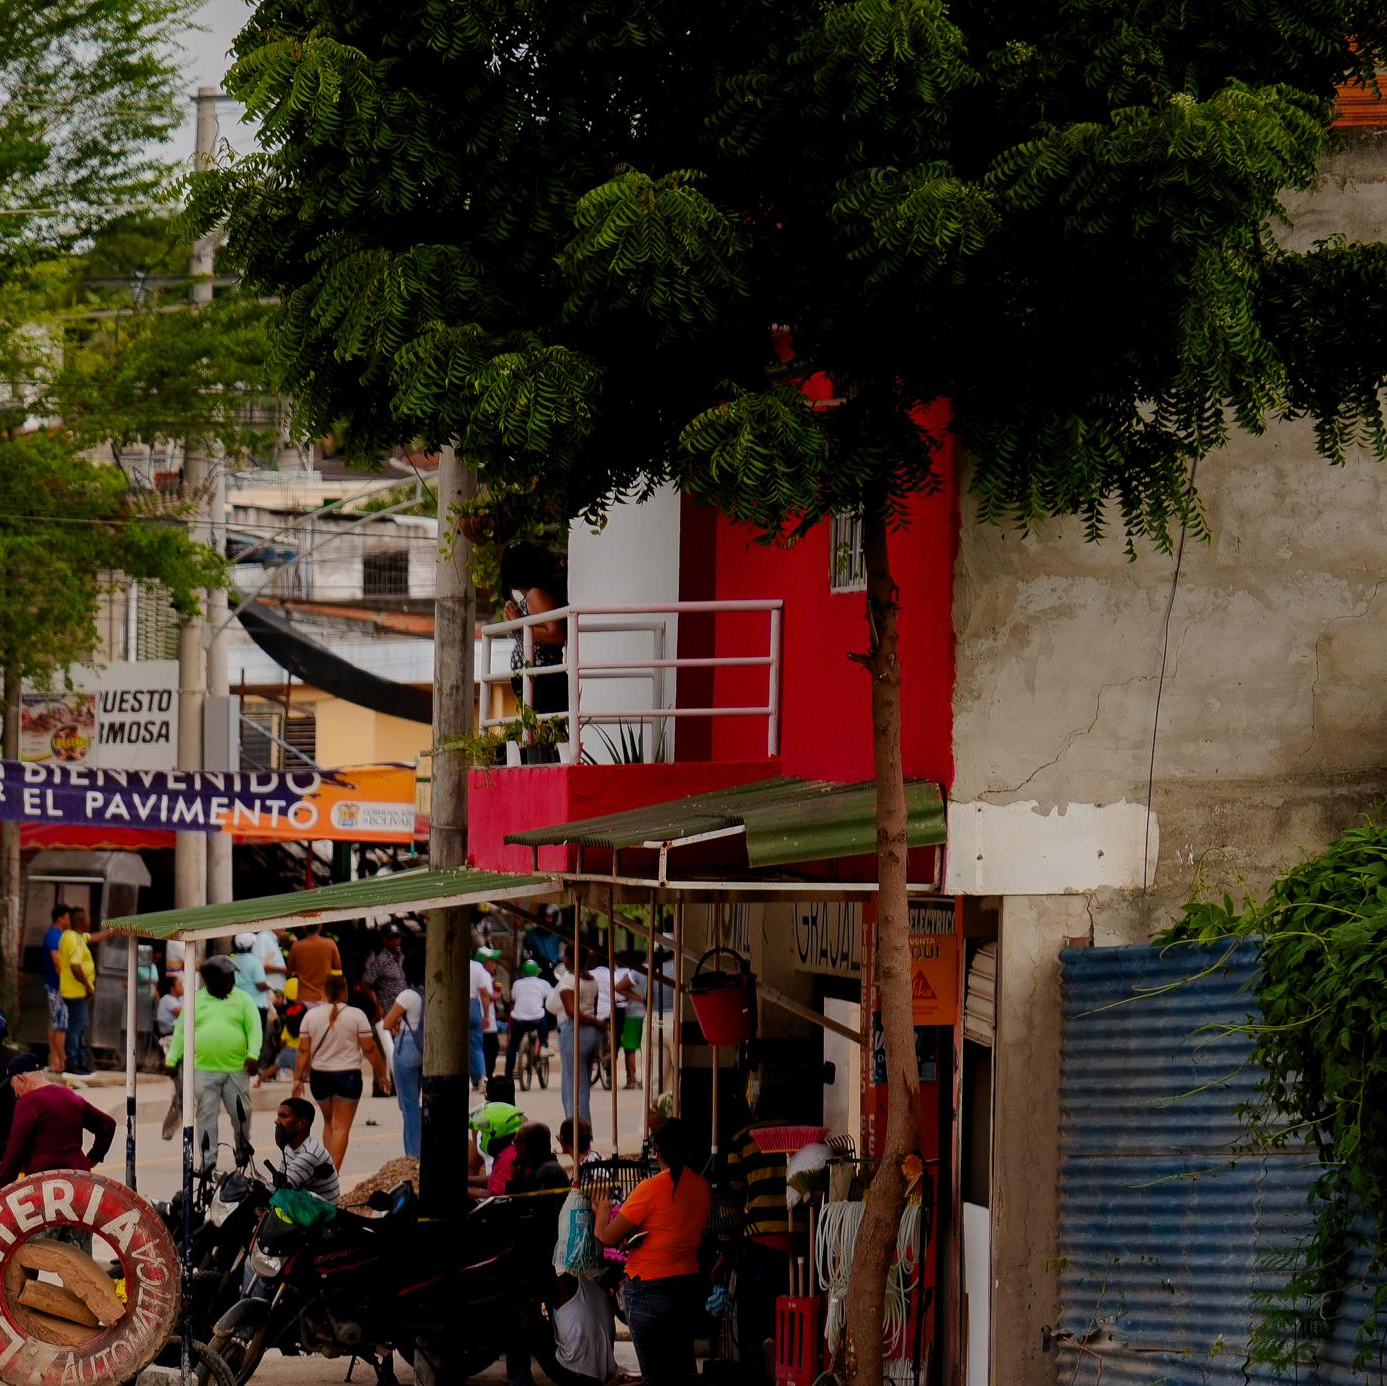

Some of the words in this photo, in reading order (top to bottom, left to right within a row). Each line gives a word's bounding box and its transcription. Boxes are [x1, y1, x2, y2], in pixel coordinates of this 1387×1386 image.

[99, 690, 172, 713] UESTO
[22, 762, 322, 796] BIENVENIDO
[23, 788, 64, 817] EL
[85, 790, 320, 830] PAVIMENTO
[910, 937, 936, 945] VENTA
